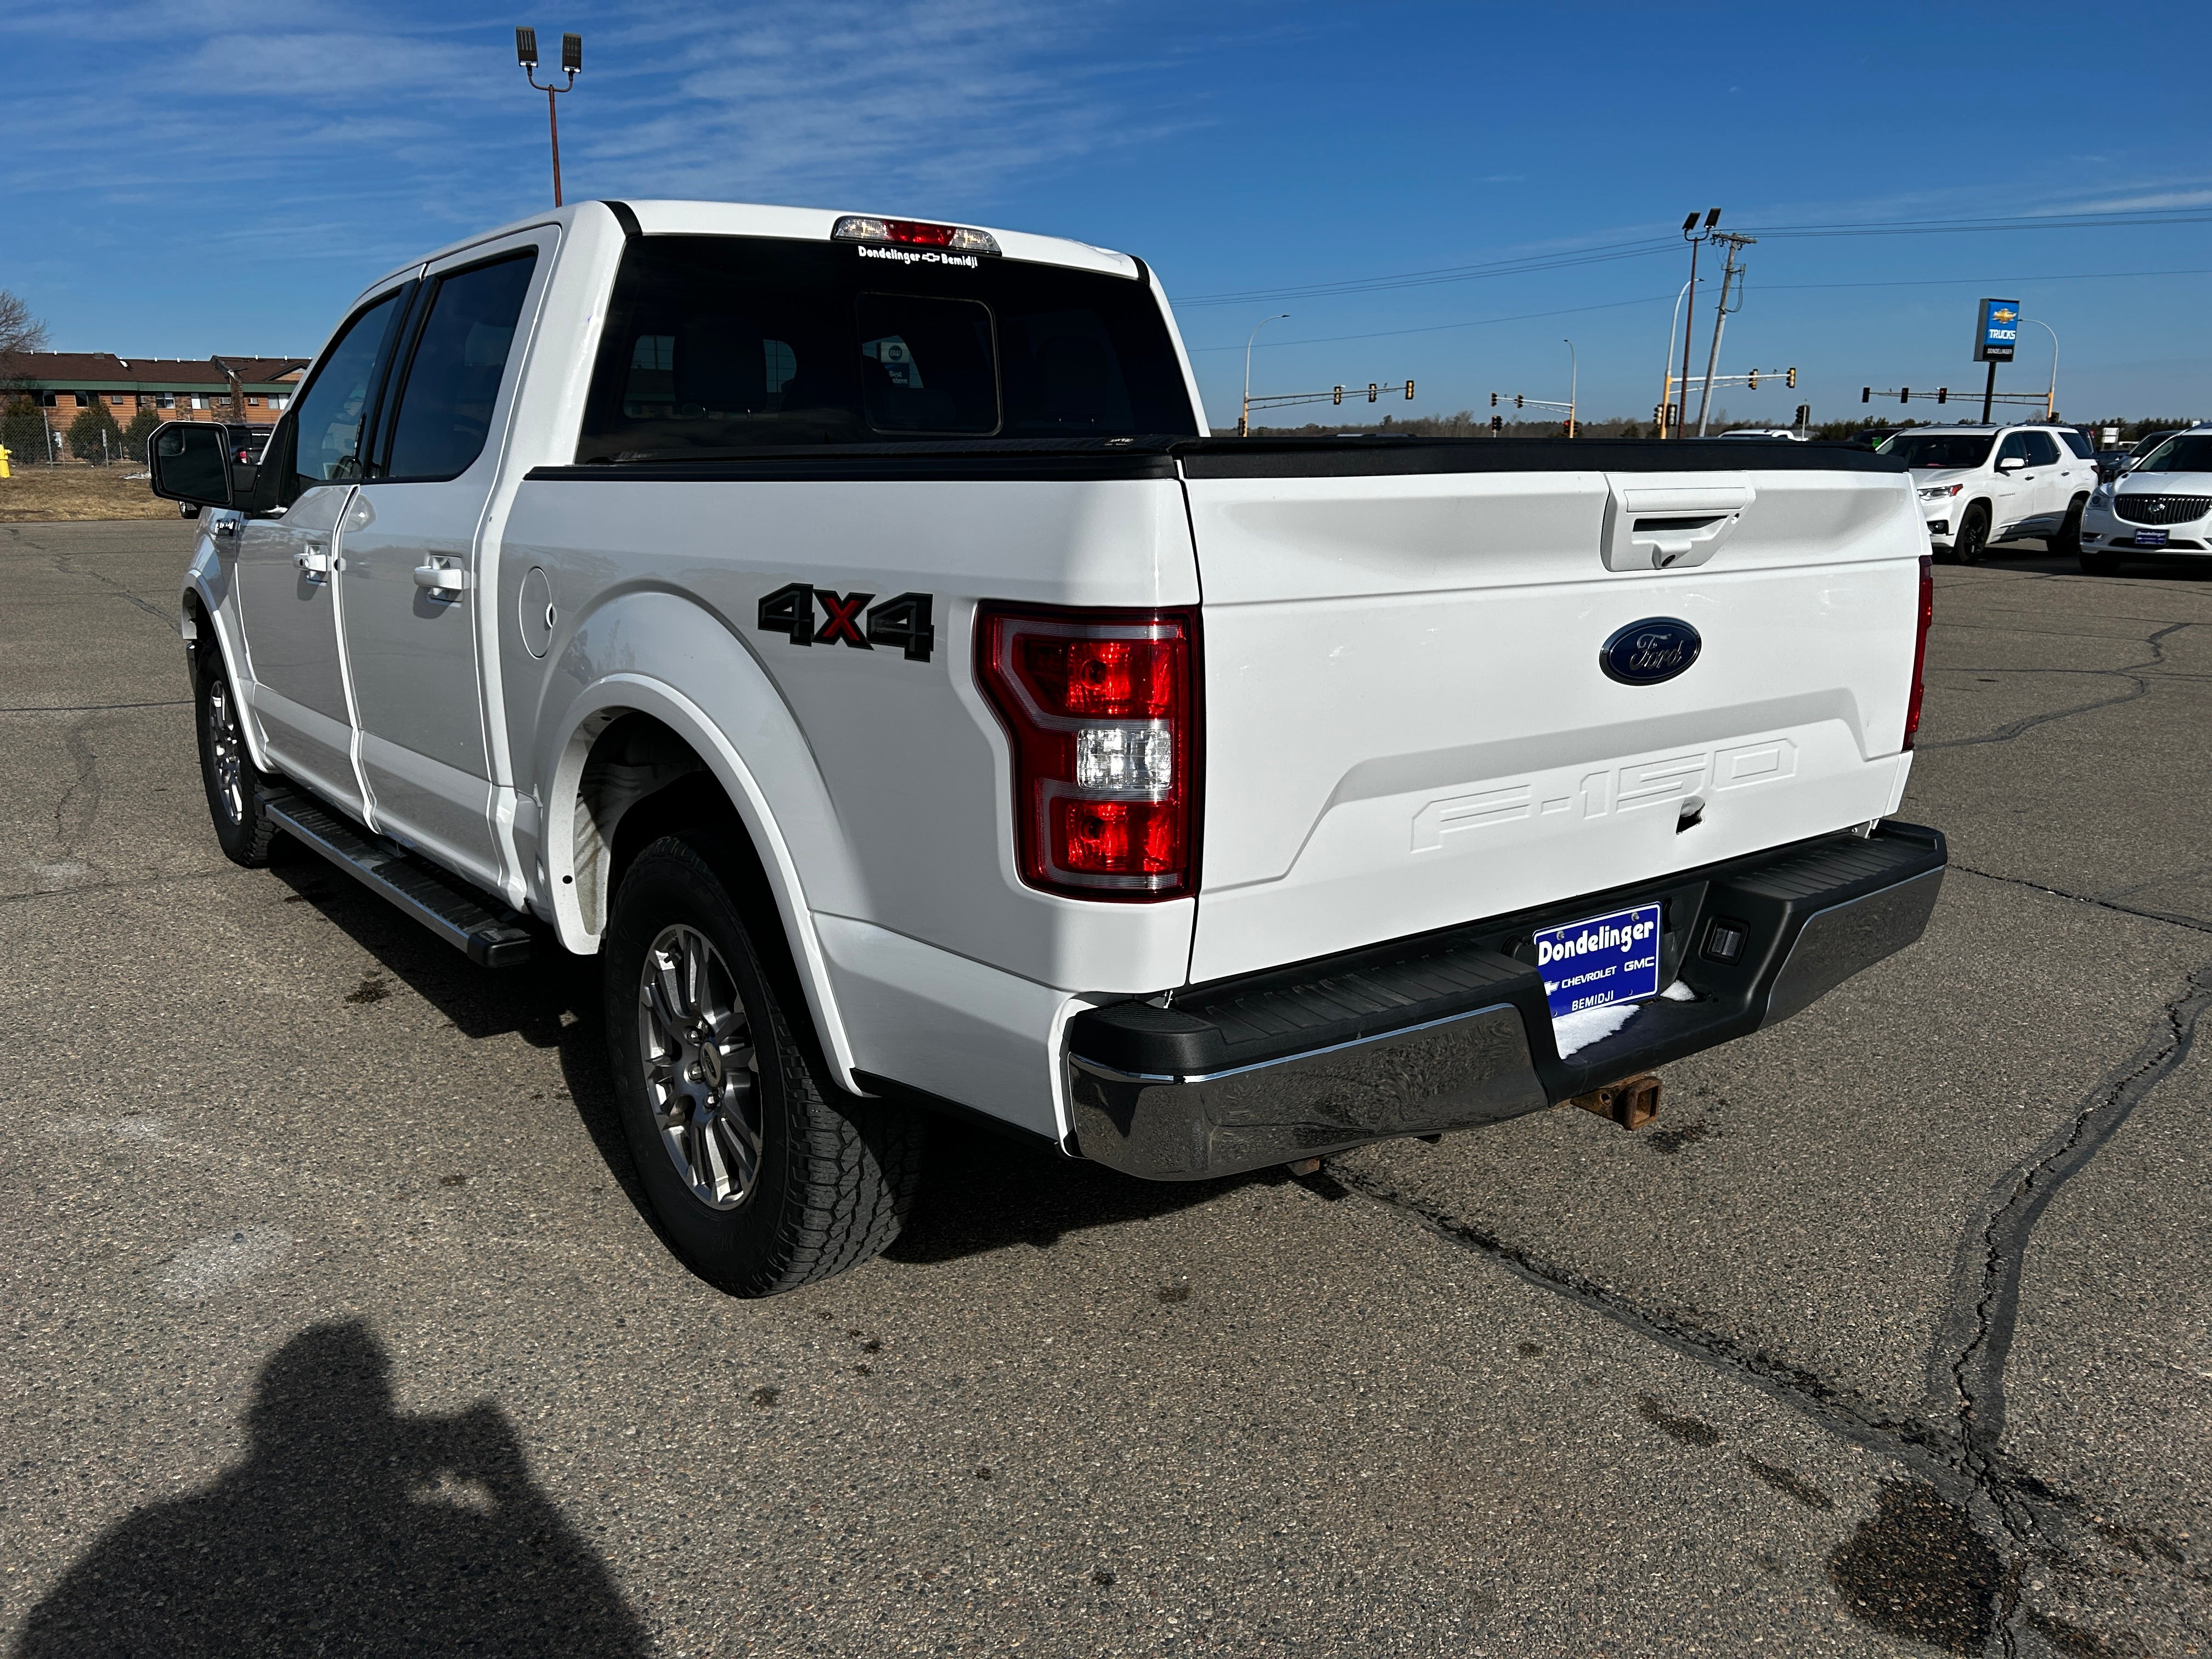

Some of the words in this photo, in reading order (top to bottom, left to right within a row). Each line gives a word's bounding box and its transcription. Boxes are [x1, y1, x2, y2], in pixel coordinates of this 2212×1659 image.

[858, 246, 920, 264] Dondelinger
[941, 253, 978, 268] Bemidji
[1989, 329, 2016, 340] TRUCKS
[1629, 633, 1684, 670] Ford
[1410, 738, 1798, 853] F-150
[1538, 921, 1654, 966] Dondelinger
[1561, 966, 1617, 988] CHEVROLET
[1624, 956, 1655, 972] GMC
[1572, 990, 1613, 1011] BEMIDJI
